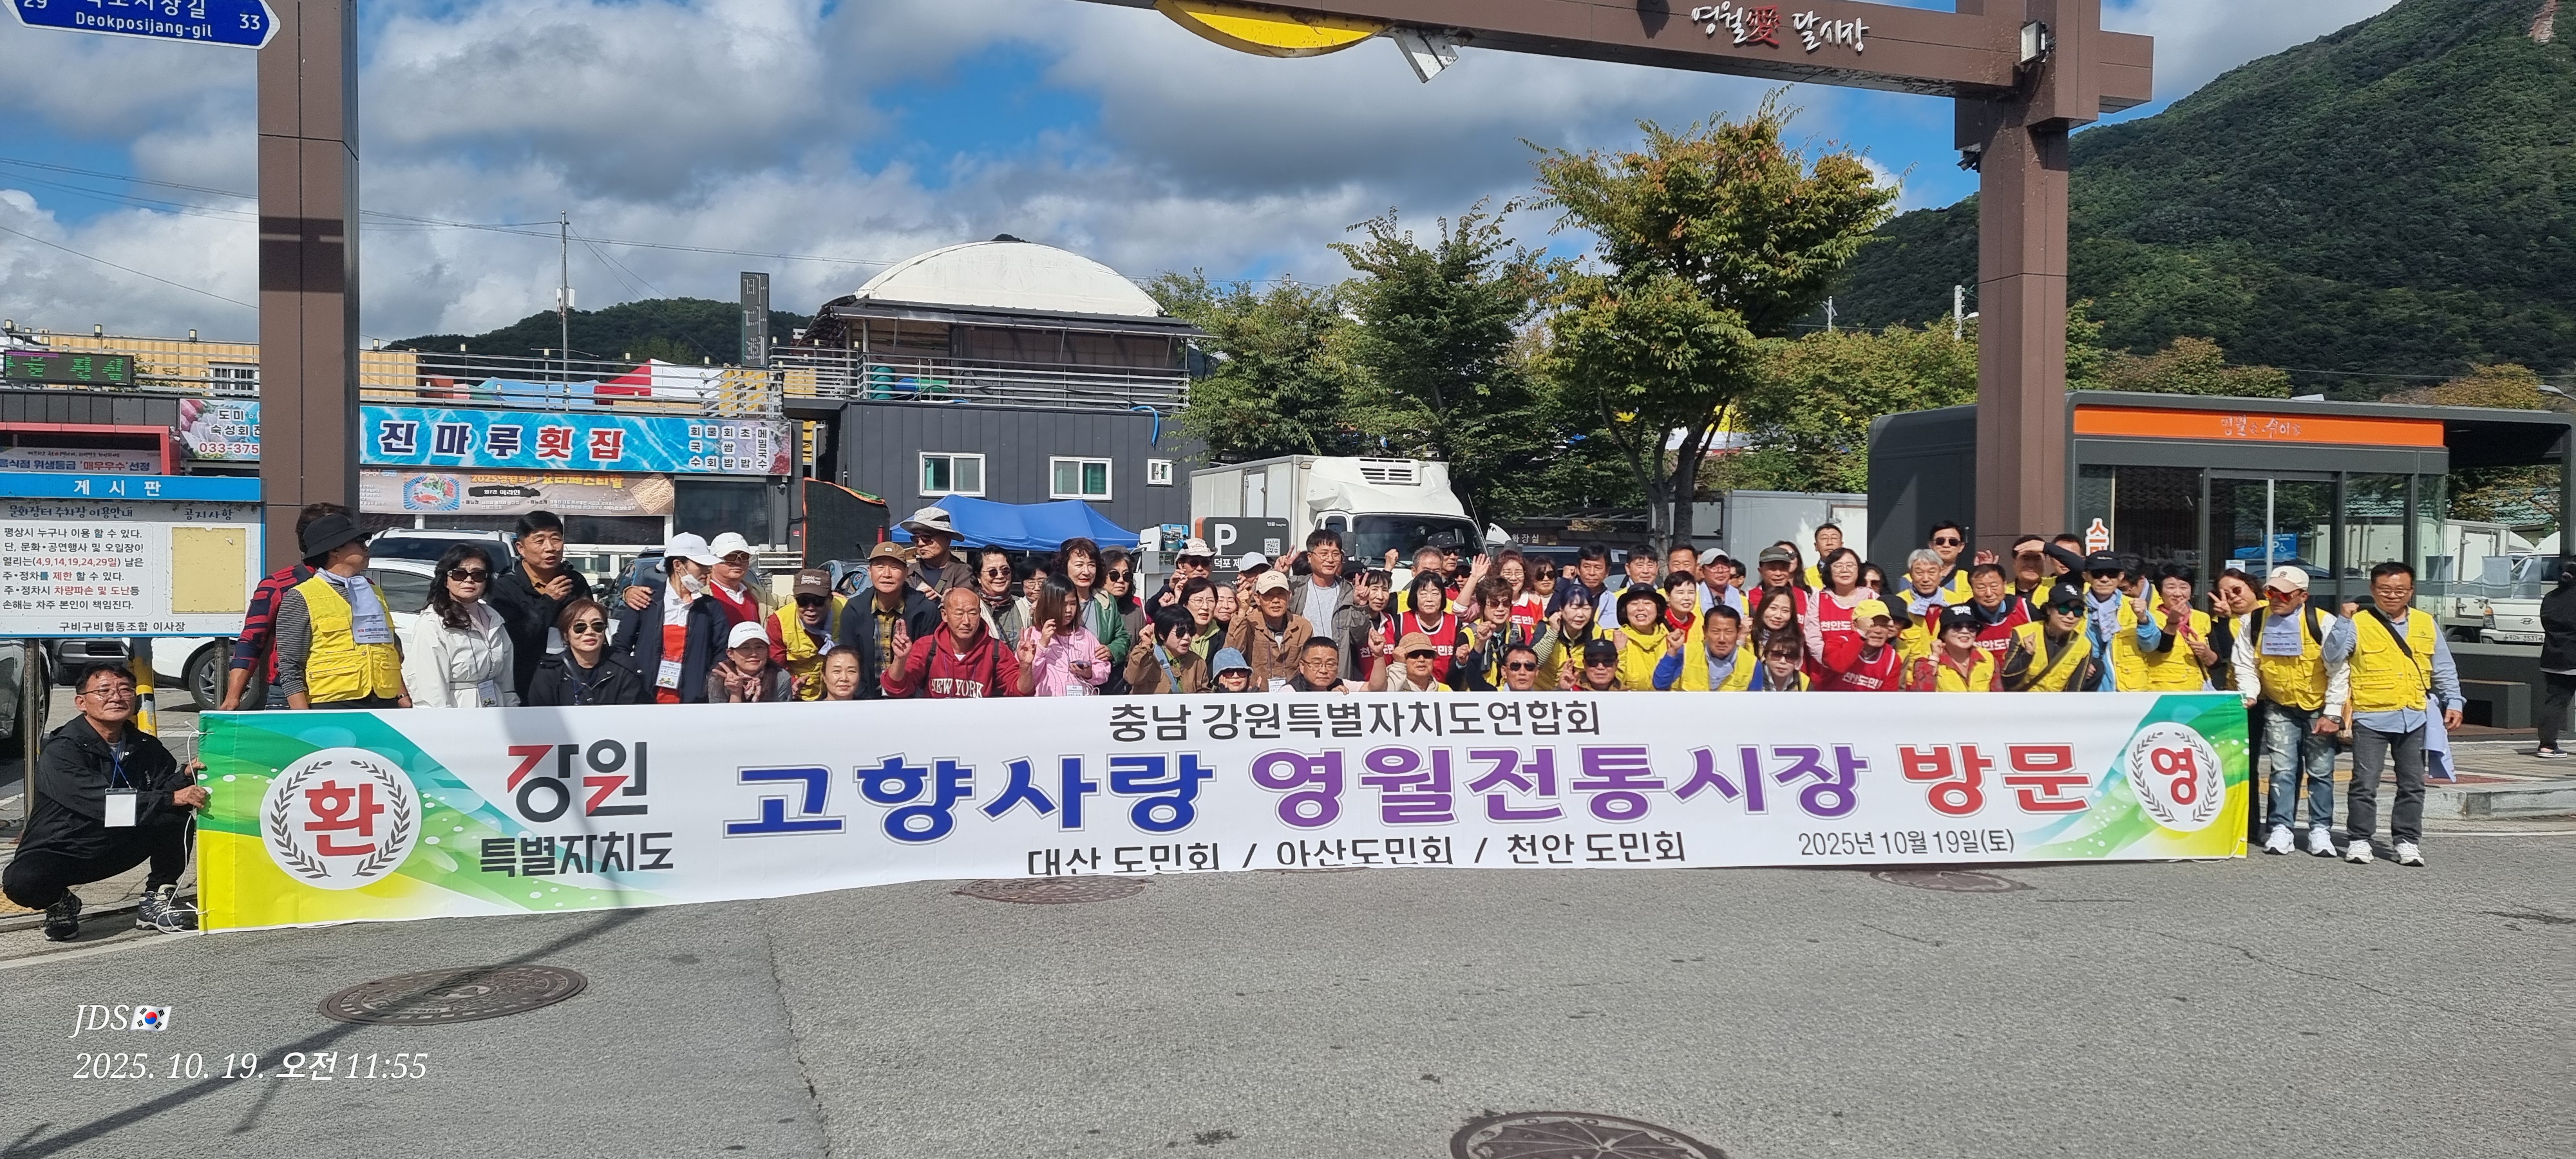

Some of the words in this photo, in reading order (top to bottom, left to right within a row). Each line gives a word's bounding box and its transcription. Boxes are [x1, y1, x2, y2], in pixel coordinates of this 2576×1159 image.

[76, 12, 213, 37] Deokposijang-gil
[239, 14, 261, 30] 33
[1792, 10, 1870, 52] 달시장
[219, 410, 243, 420] 도미
[211, 425, 249, 436] 숙성회
[199, 442, 258, 454] 033-375
[90, 506, 133, 519] 이용안내
[185, 508, 234, 521] 공지사항
[4, 527, 33, 537] 평상시
[37, 528, 67, 538] 누구나
[71, 528, 90, 538] 이용
[94, 529, 103, 538] 할
[107, 529, 117, 538] 수
[120, 529, 142, 538] 있다.
[1215, 523, 1237, 556] P
[5, 542, 17, 552] 단,
[91, 543, 100, 552] 및
[104, 543, 144, 552] 오일장이
[124, 558, 144, 567] 날은
[1214, 558, 1231, 569] 덕포
[52, 572, 73, 581] 제한
[75, 572, 86, 581] 할
[89, 572, 99, 581] 수
[102, 572, 124, 581] 있다.
[54, 586, 94, 596] 차량파손
[97, 586, 106, 596] 및
[110, 586, 140, 596] 도난등
[3, 600, 33, 610] 손해는
[35, 600, 56, 610] 차주
[59, 600, 88, 610] 본인이
[92, 600, 134, 610] 책임진다.
[59, 622, 148, 632] 구비구비협동조합
[153, 622, 185, 632] 이사장
[931, 678, 953, 695] NEW
[955, 679, 984, 698] YORK
[1110, 703, 1191, 742] 충남
[1202, 699, 1600, 740] 강원특별자치도연합회
[507, 739, 649, 823] 강원
[2150, 745, 2197, 806] 영
[723, 750, 1217, 845] 고향사랑
[1248, 743, 1871, 831] 영월전통시장
[1896, 741, 2093, 818] 방문
[304, 779, 384, 857] 환
[1798, 831, 1877, 856] 2025년
[1880, 831, 1928, 855] 10월
[1937, 829, 2016, 854] 19일(토)
[480, 831, 674, 877] 특별자치도
[1027, 845, 1101, 875] 대산
[1113, 842, 1219, 874] 도민회
[1277, 835, 1454, 867] 아산도민회
[1507, 833, 1576, 864] 천안
[1586, 831, 1687, 863] 도민회
